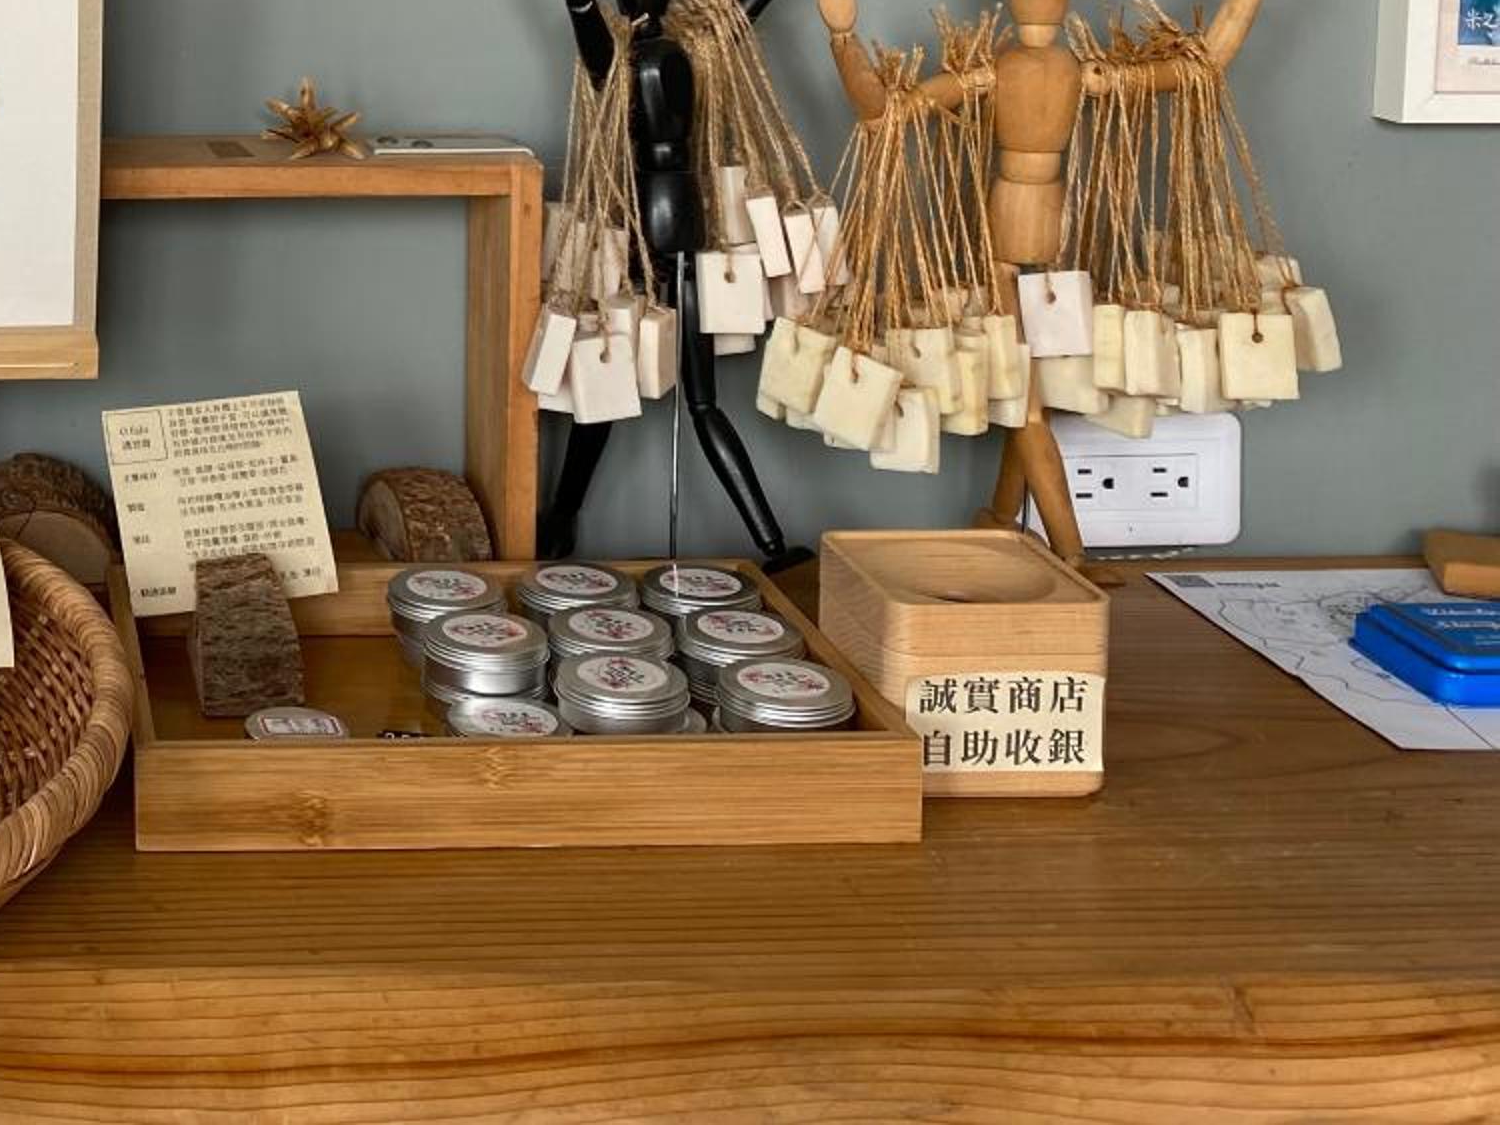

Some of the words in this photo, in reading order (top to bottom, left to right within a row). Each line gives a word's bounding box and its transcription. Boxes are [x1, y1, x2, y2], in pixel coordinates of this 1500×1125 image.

[918, 676, 1088, 714] 誠實商店
[921, 728, 1087, 767] 自助收銀
